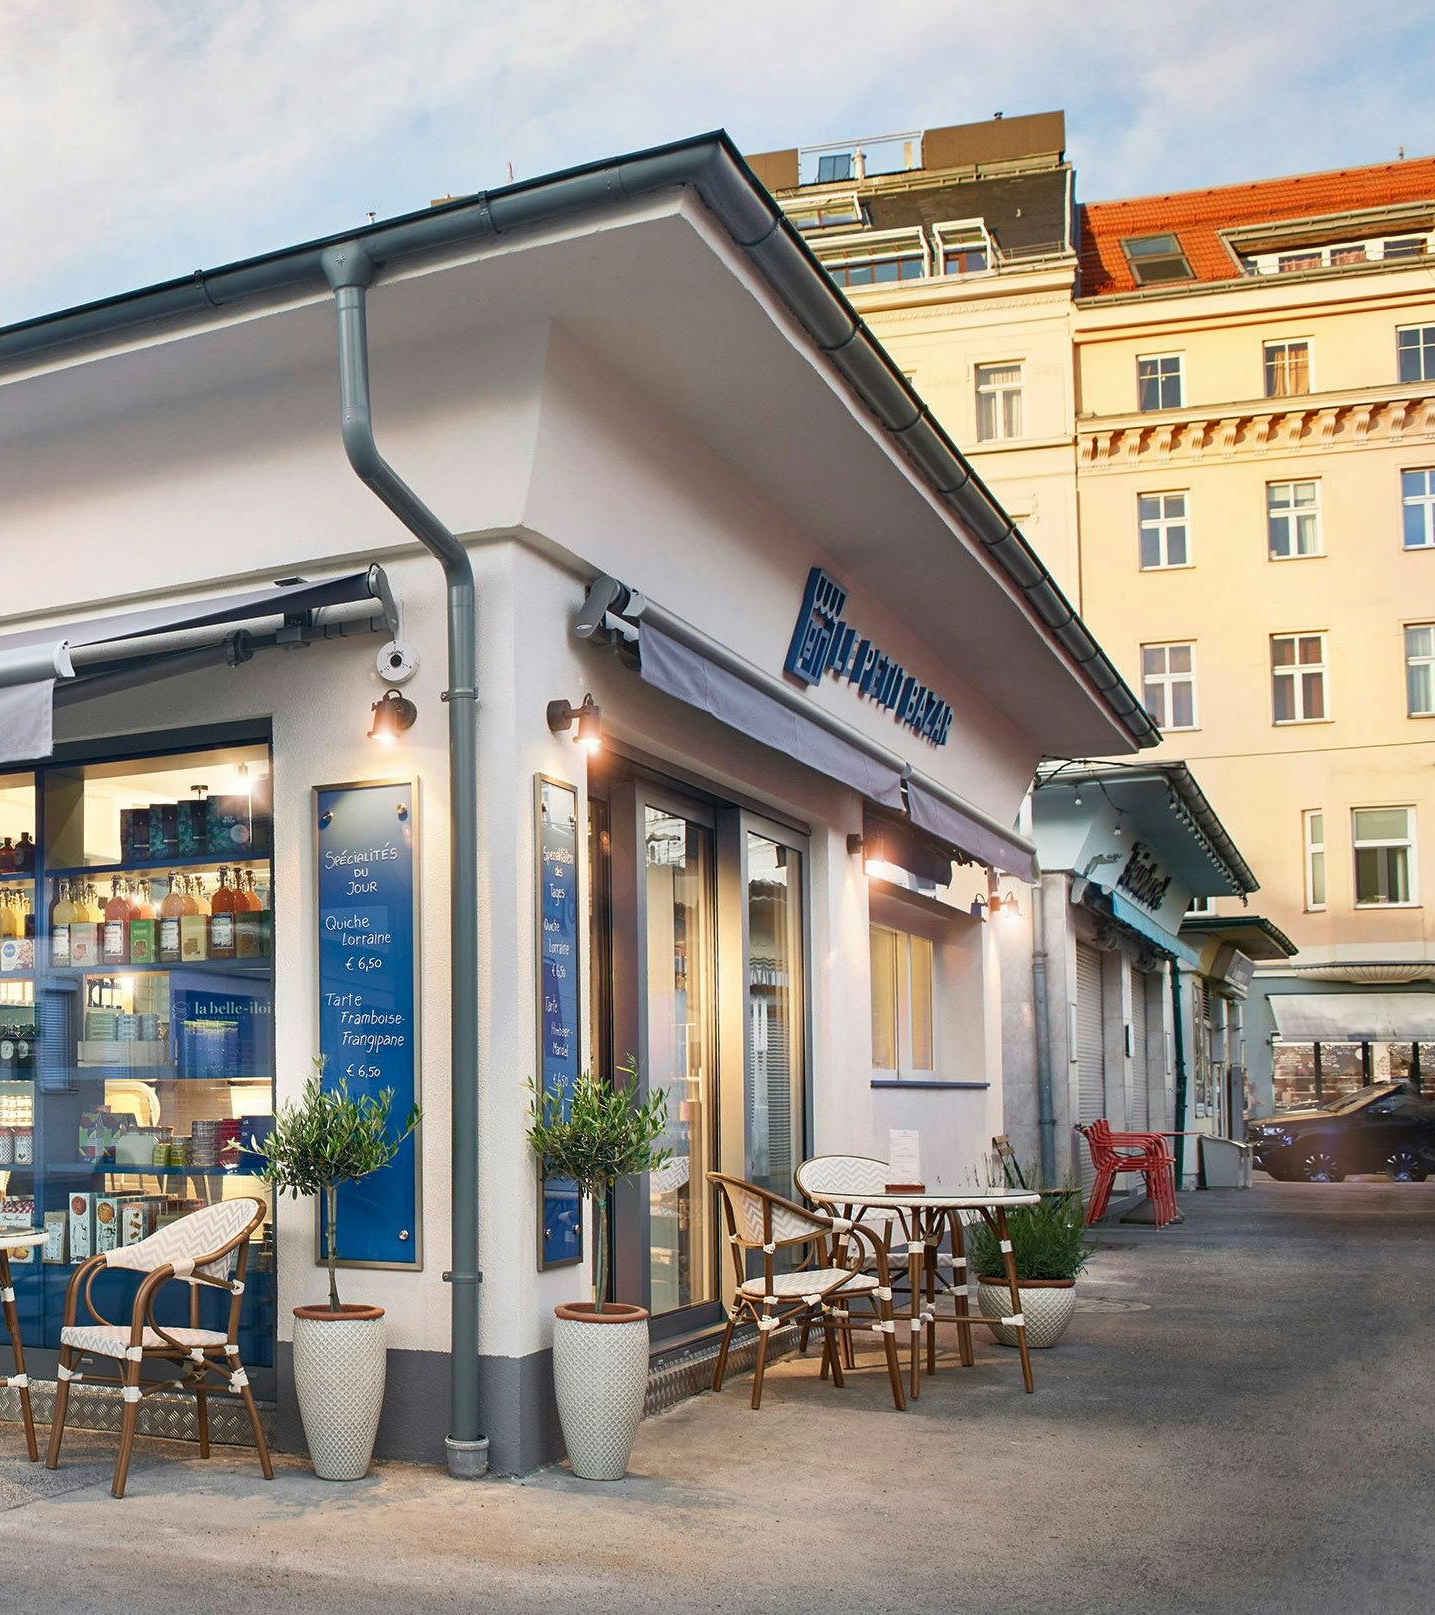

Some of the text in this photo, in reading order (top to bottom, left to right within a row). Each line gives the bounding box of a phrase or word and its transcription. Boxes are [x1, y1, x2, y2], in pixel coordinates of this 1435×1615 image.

[826, 620, 955, 747] LE PETIT BAZAR
[353, 867, 369, 878] DU
[554, 865, 564, 878] des
[346, 881, 378, 896] JOUR
[549, 883, 566, 907] Tages
[325, 914, 370, 931] Quiche
[342, 931, 392, 946] Lorraine
[548, 938, 570, 956] Lorraine
[345, 956, 383, 972] € 6,50
[325, 992, 362, 1007] Tarte
[194, 1001, 208, 1015] la
[342, 1030, 405, 1054] Frangipane
[346, 1063, 381, 1079] € 6,50
